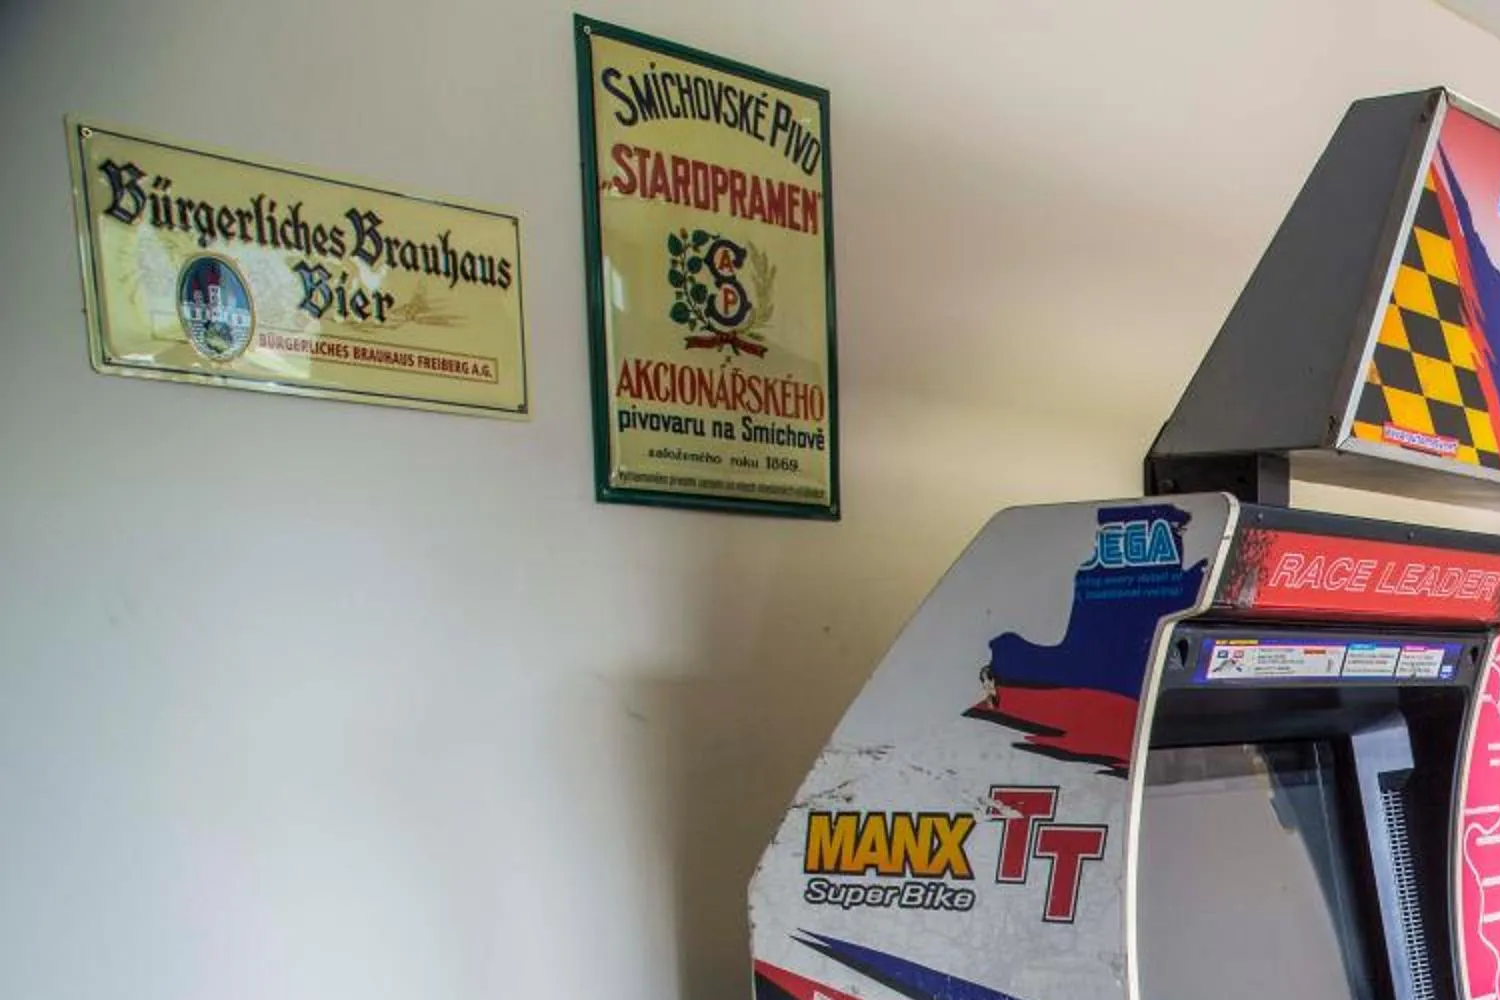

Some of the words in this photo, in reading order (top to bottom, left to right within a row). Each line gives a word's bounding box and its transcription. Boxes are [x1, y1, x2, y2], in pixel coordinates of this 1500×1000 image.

[770, 100, 821, 176] PIVO
[98, 159, 346, 258] Bürgerliches
[345, 208, 512, 290] Brauhaus
[294, 261, 395, 323] Bier
[259, 331, 349, 359] BÜRGERLICHES
[353, 348, 415, 370] BRAUHAUS
[417, 354, 469, 374] FREIBERG
[471, 360, 494, 378] A.G.
[617, 405, 705, 433] pivovaru
[712, 420, 736, 441] na
[1269, 552, 1376, 592] RACE
[804, 811, 976, 880] MANX
[990, 786, 1108, 923] TT
